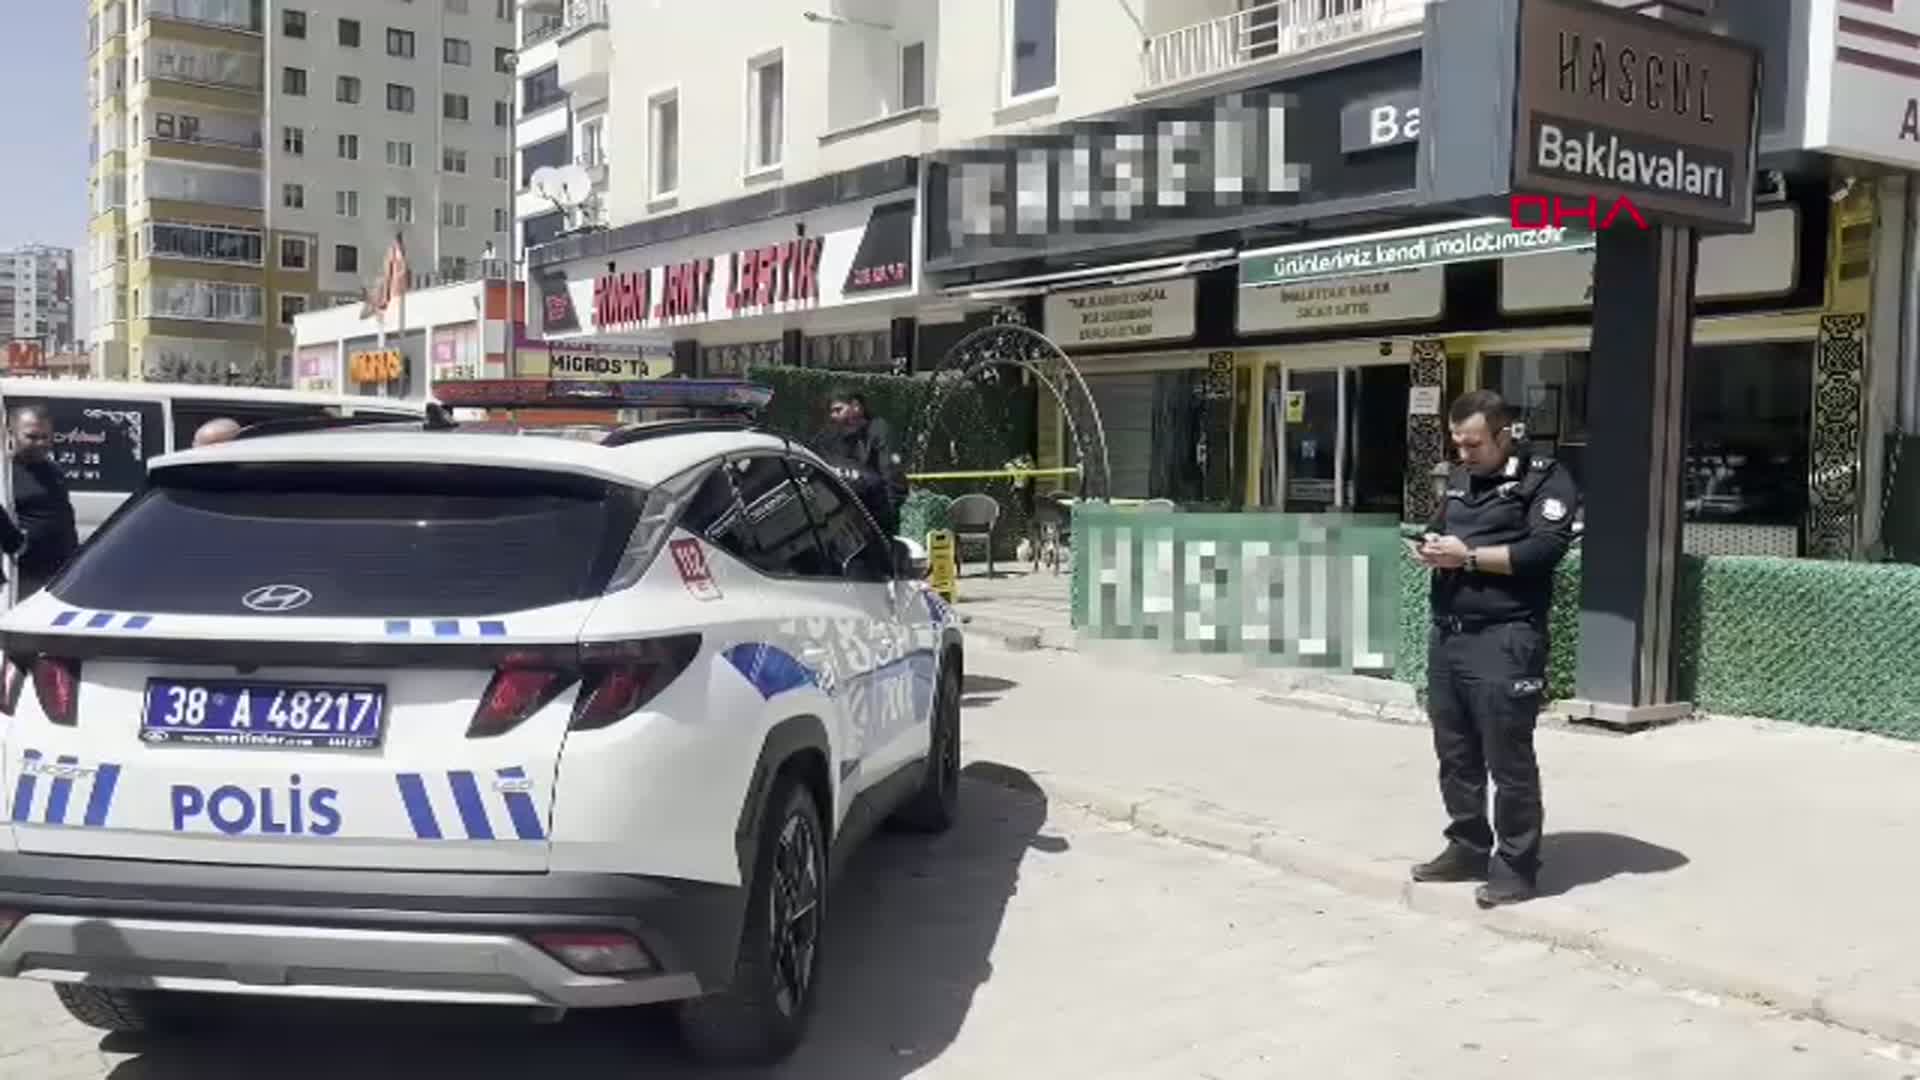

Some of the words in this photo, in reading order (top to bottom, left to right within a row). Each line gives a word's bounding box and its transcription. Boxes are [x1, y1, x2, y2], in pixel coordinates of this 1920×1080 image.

[1538, 124, 1724, 199] Baklavaları
[164, 686, 209, 725] 38
[230, 690, 252, 728] A
[266, 691, 374, 732] 48217
[170, 774, 342, 836] POLİS
